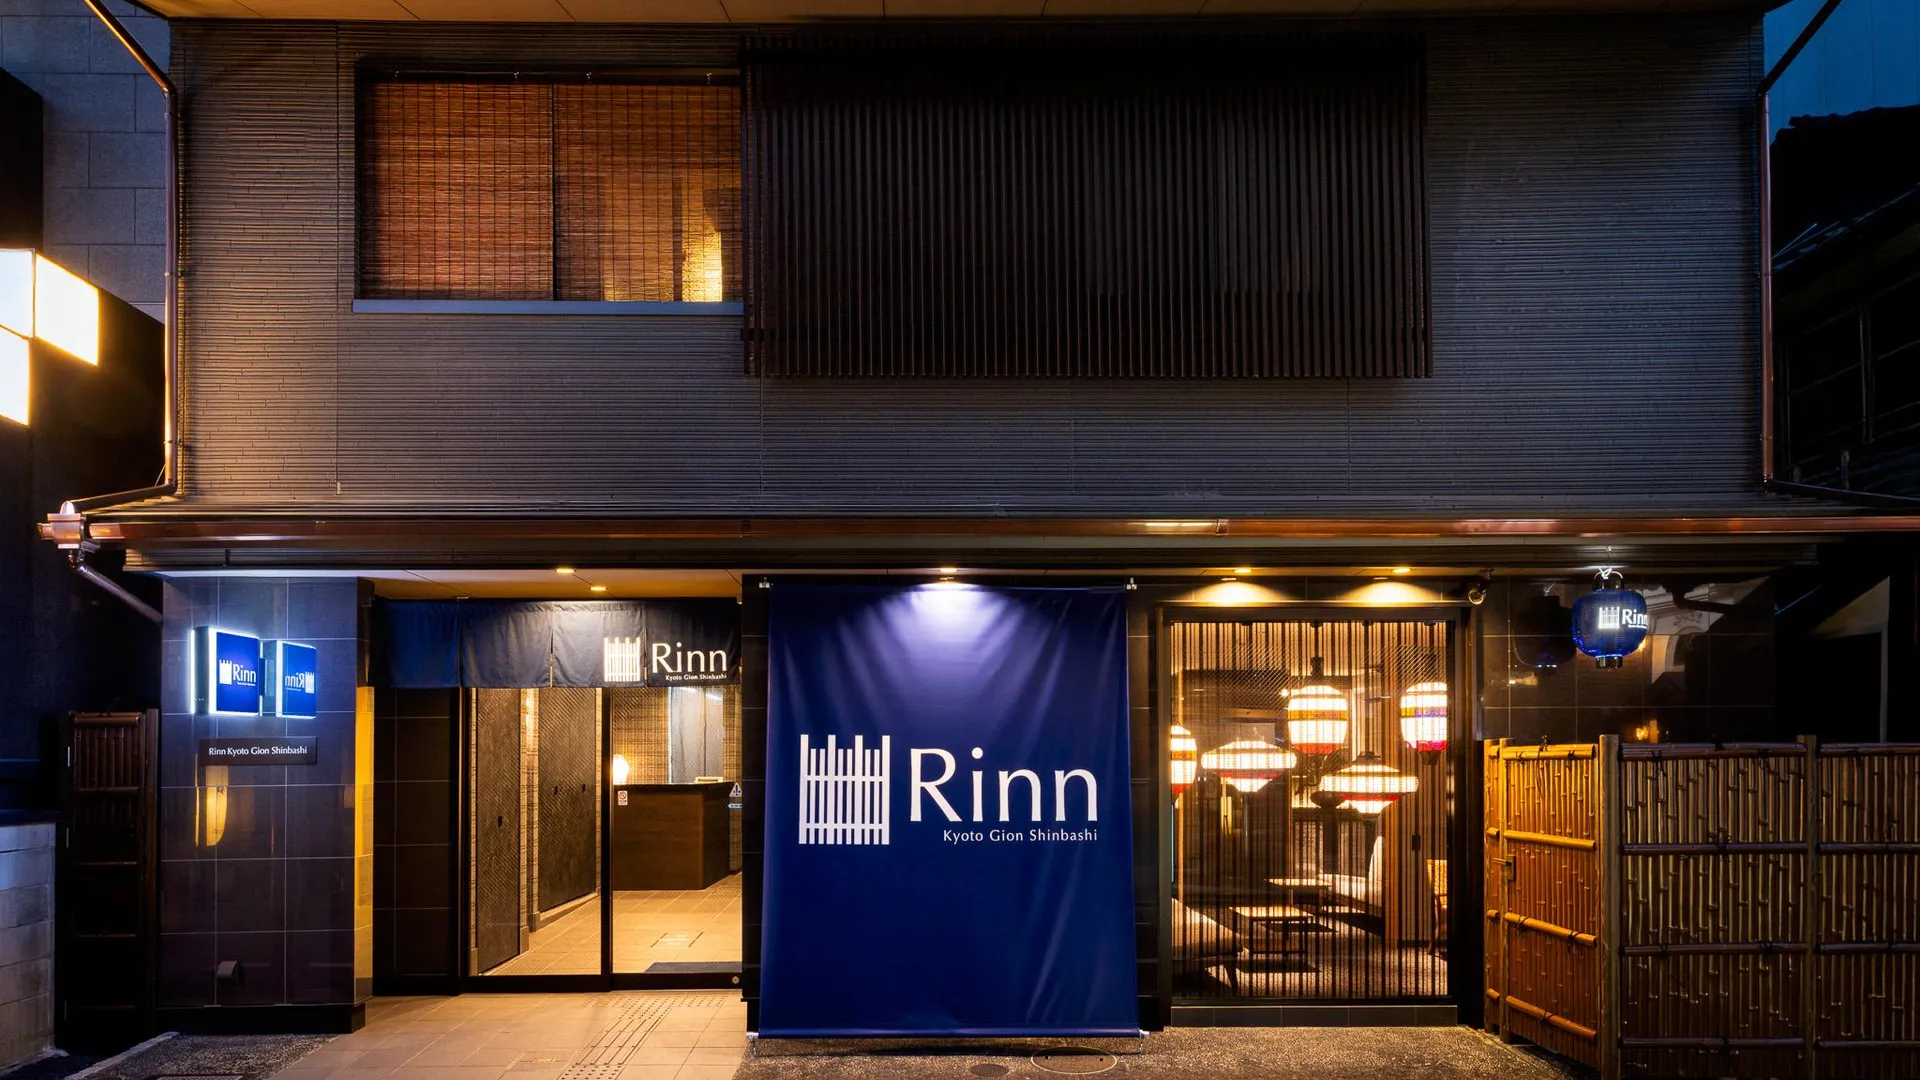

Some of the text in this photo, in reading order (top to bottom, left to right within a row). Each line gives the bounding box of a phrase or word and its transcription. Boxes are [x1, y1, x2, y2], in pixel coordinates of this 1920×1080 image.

[652, 641, 728, 673] Rinn
[233, 664, 256, 683] Rinn
[665, 674, 682, 682] Kyoto
[699, 672, 728, 680] Shinbashi
[208, 745, 308, 757] Rinn Kyoto Gion Shinbashi
[910, 746, 1098, 822] Rinn
[943, 828, 1098, 845] Kyoto Gion Shinbashi
